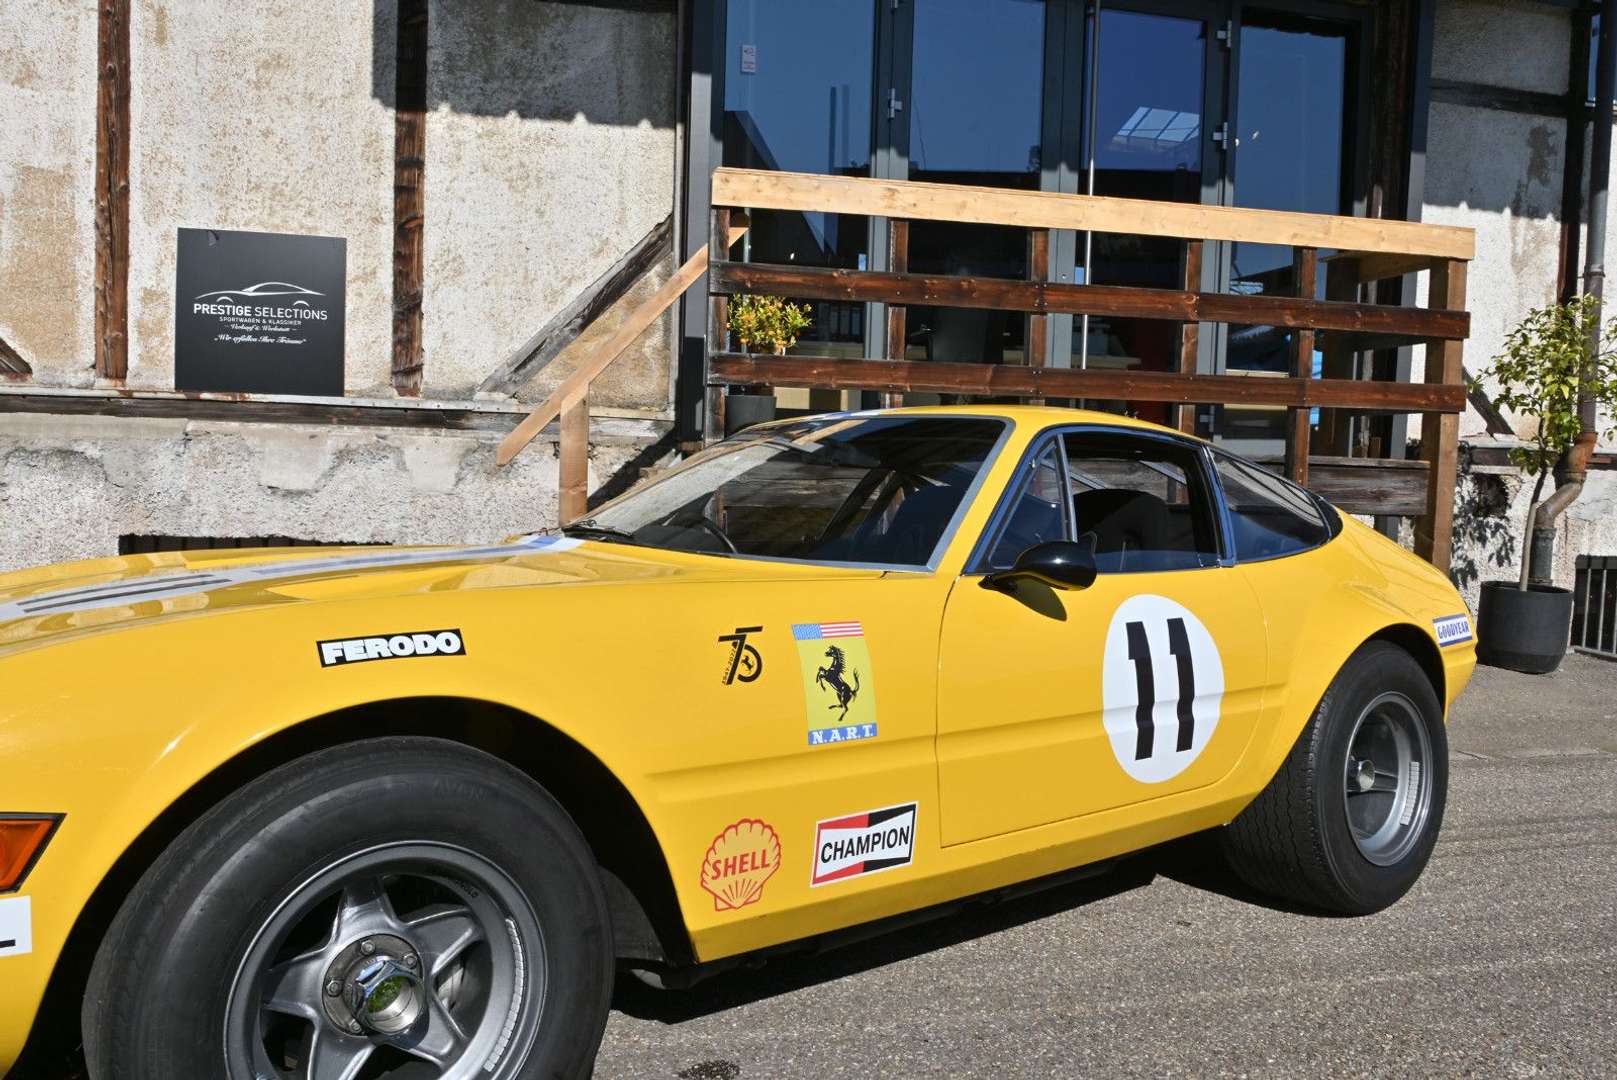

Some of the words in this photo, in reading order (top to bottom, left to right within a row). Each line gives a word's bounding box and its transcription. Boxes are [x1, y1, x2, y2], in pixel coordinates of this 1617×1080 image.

[193, 303, 252, 317] PRESTIGE
[254, 306, 328, 321] SELECTIONS
[1437, 620, 1470, 639] GOODYEAR
[321, 631, 461, 665] FERODO
[718, 626, 763, 685] 75
[1126, 617, 1195, 761] 11
[811, 723, 875, 745] N.A.R.T.
[820, 825, 910, 864] CHAMPION
[711, 848, 771, 880] SHELL
